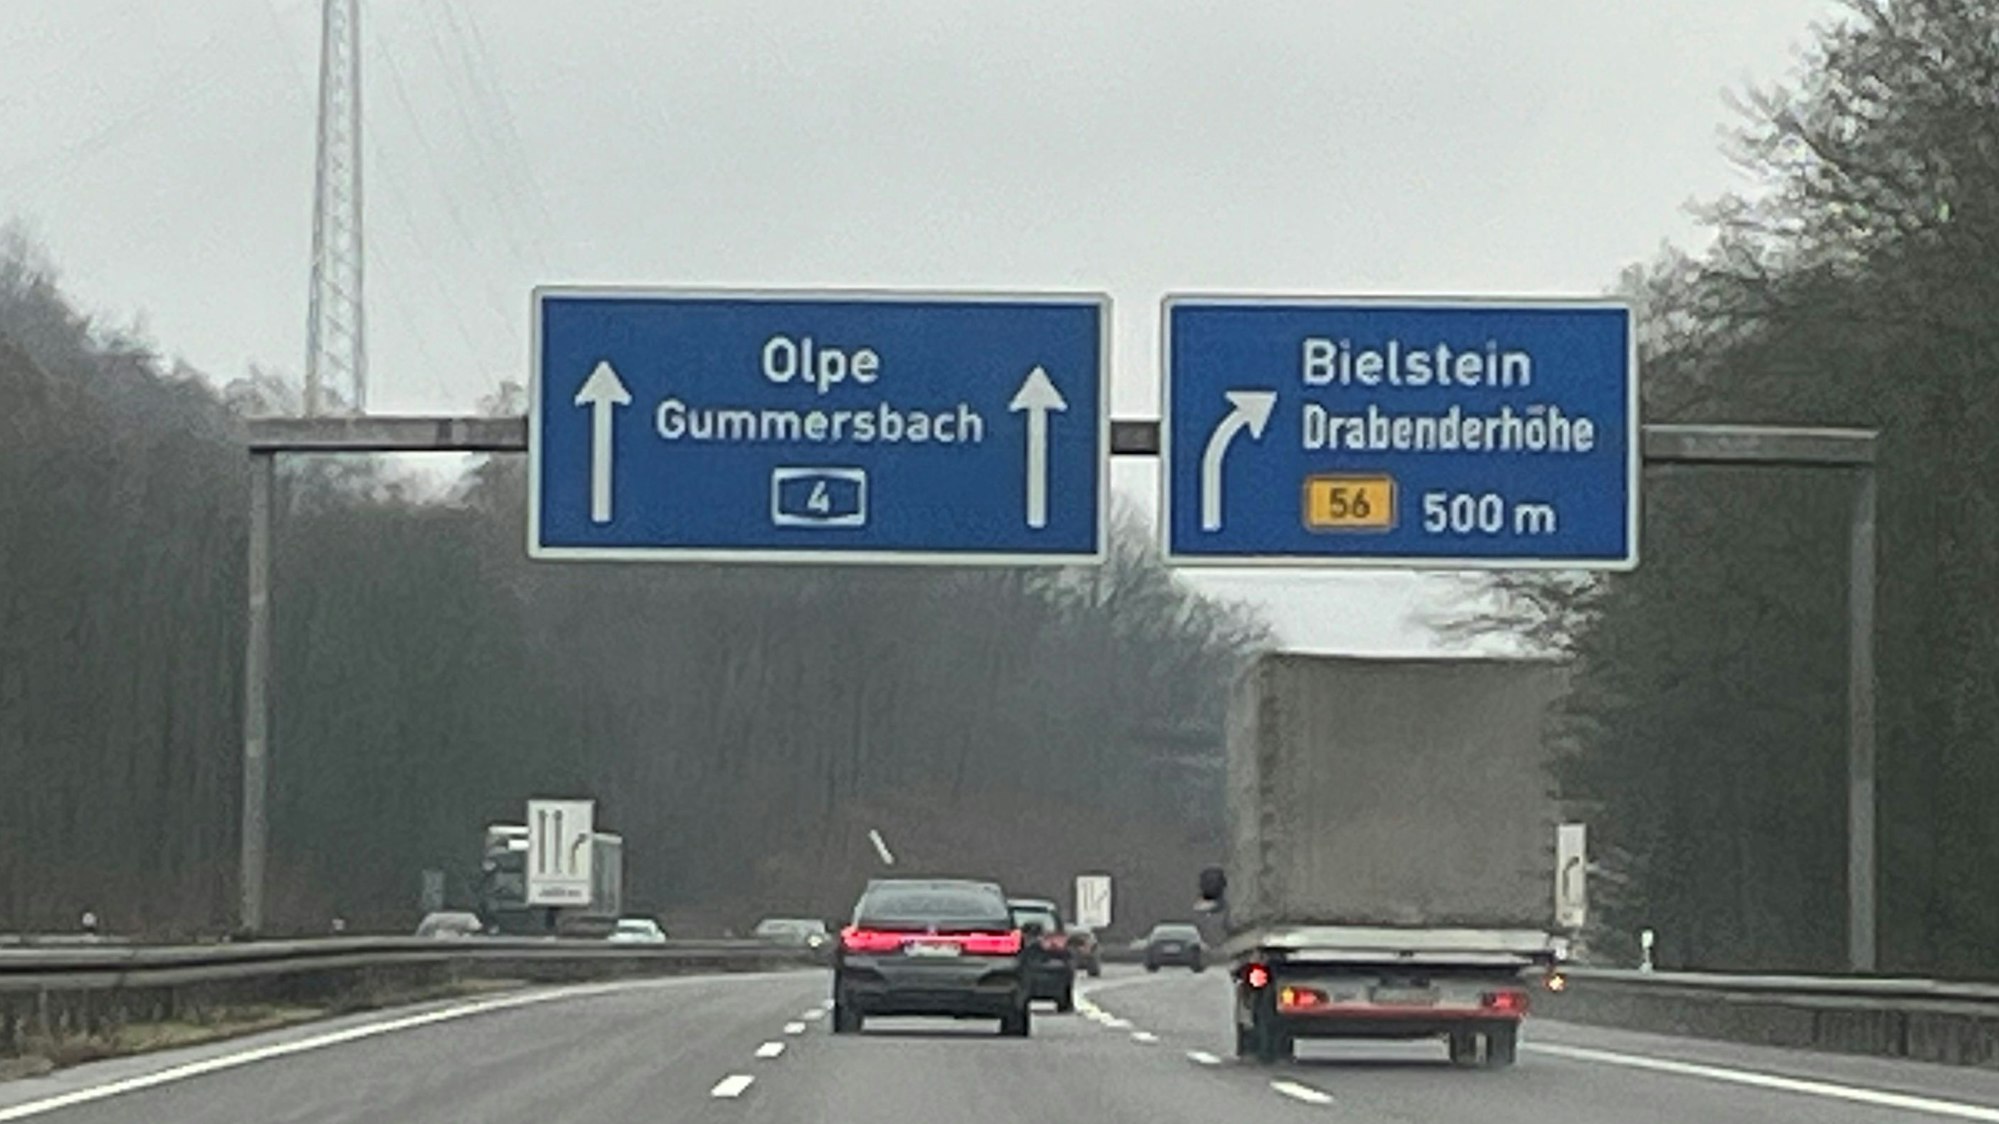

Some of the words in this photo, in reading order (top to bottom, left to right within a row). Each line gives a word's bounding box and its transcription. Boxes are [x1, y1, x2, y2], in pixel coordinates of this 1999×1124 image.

[762, 337, 880, 394] Olpe
[1302, 337, 1532, 387] Bielstein
[656, 399, 984, 444] Gummersbach
[1302, 402, 1595, 453] Drabenderhöhe
[806, 481, 830, 514] 4
[1328, 487, 1372, 519] 56
[1423, 493, 1503, 534] 500
[1514, 501, 1556, 534] m
